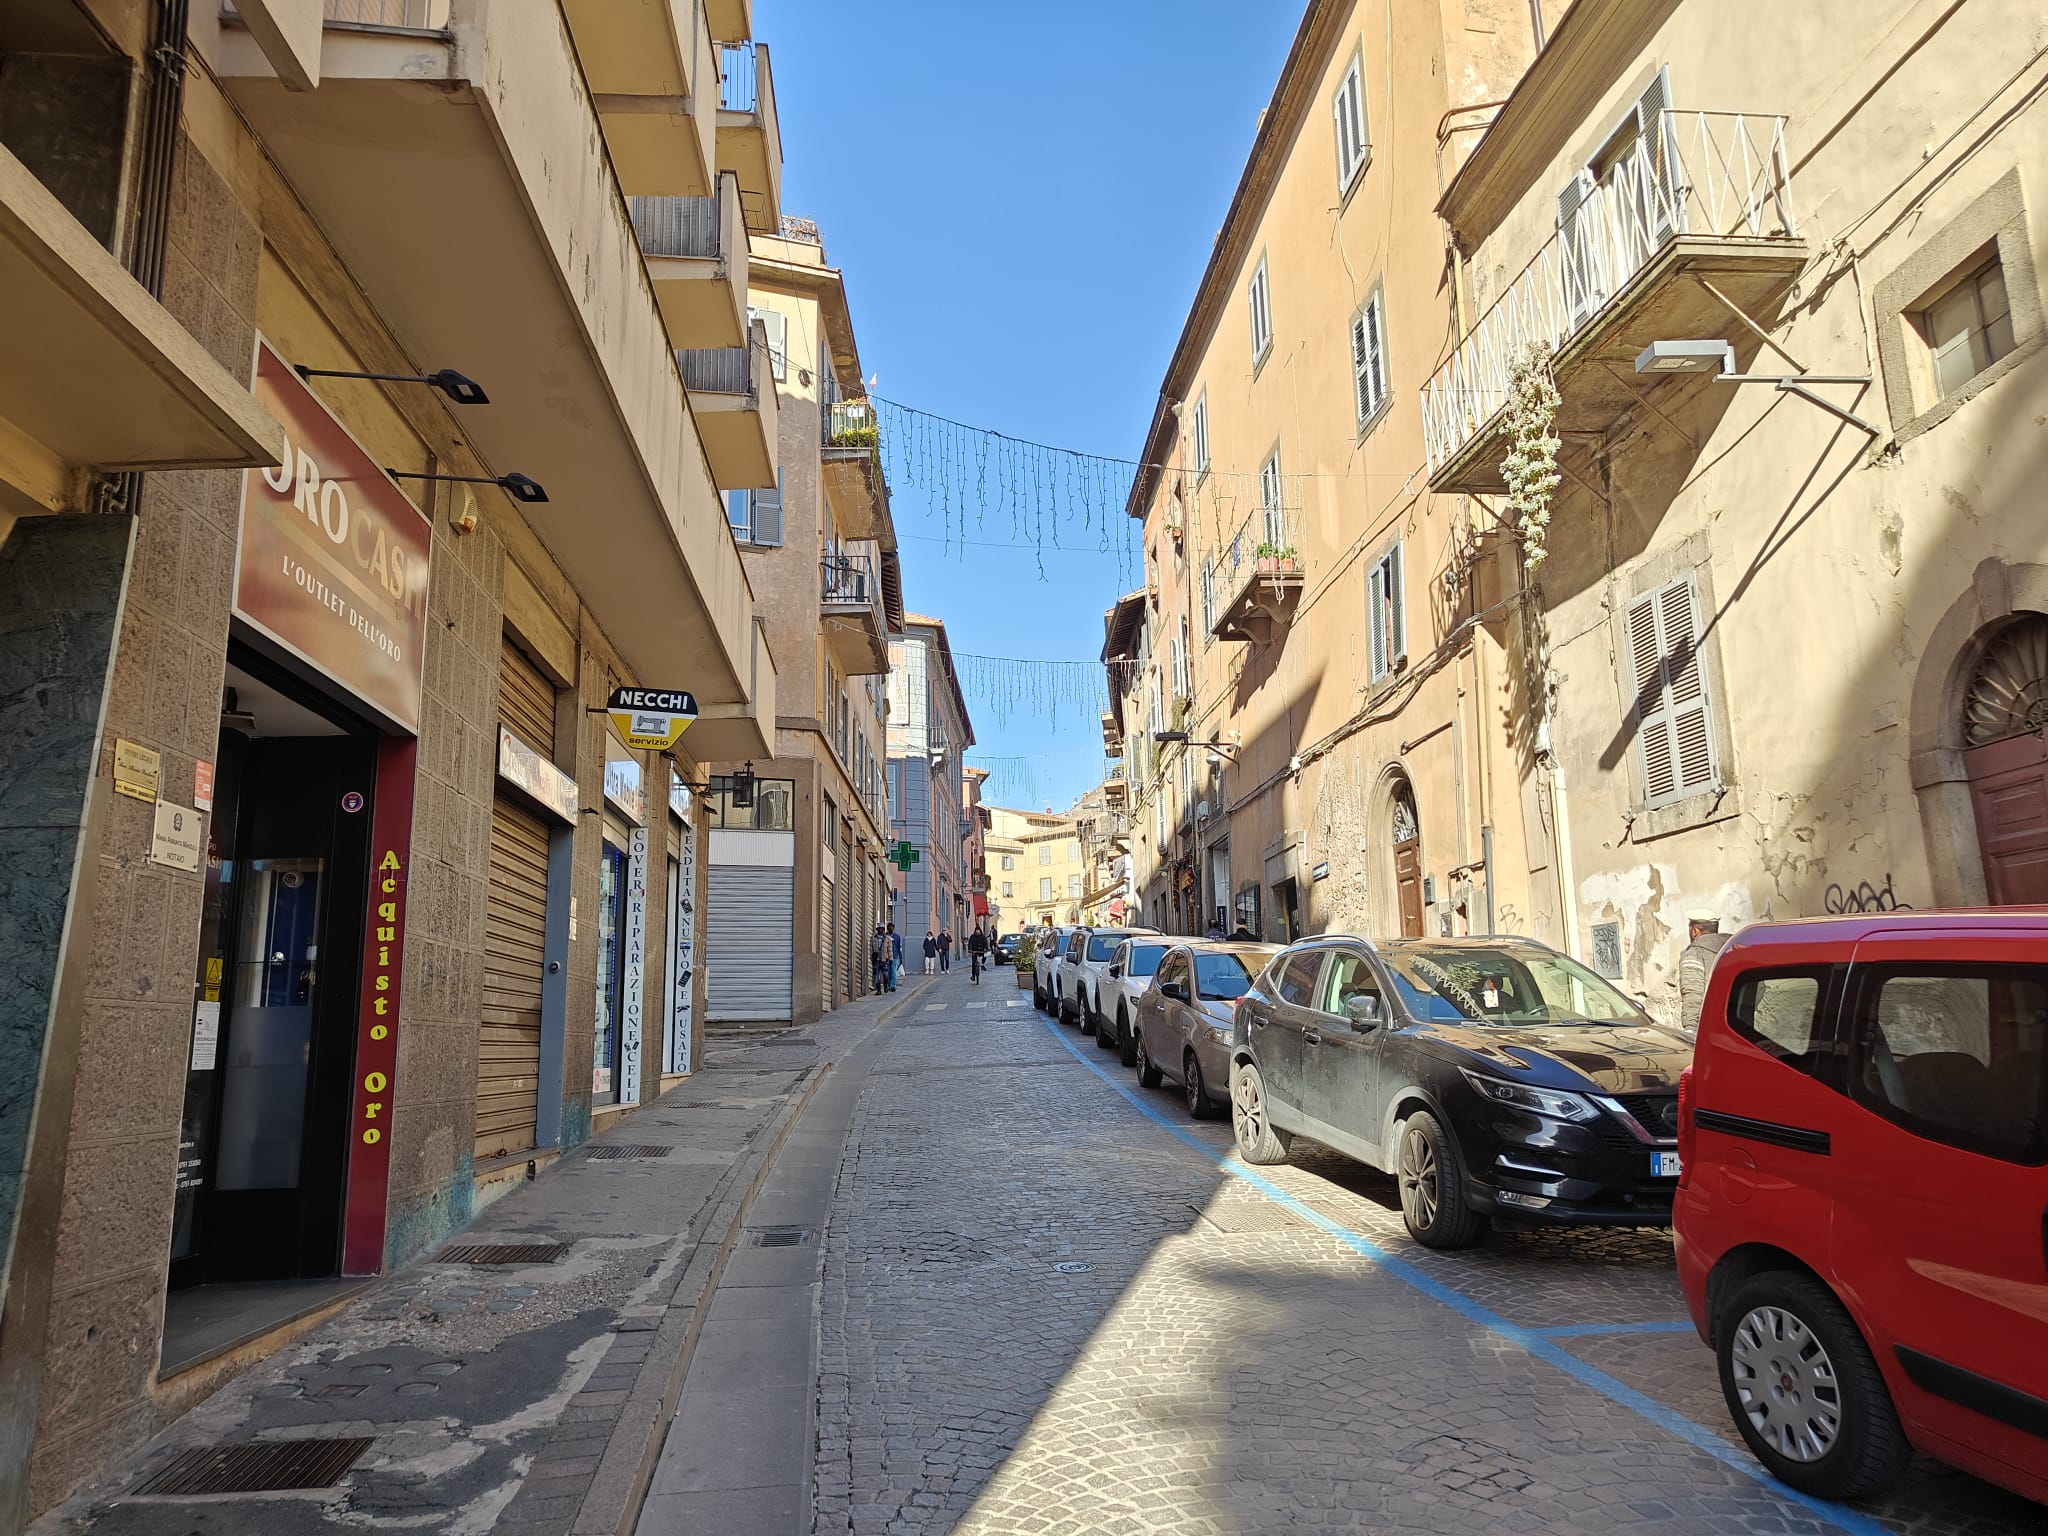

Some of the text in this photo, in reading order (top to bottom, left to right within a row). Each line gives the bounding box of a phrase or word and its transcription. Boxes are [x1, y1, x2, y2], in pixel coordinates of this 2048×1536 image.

[282, 554, 401, 662] L'OUTLET DELL'ORO
[619, 690, 688, 710] NECCHI
[629, 737, 669, 746] servizio
[633, 829, 645, 890] COVER
[369, 850, 401, 1041] Acquisto
[628, 902, 642, 1042] RIPARAZIONE
[681, 990, 688, 1000] E
[677, 1018, 688, 1073] USATO
[627, 1051, 637, 1102] CELL
[362, 1071, 387, 1145] Oro
